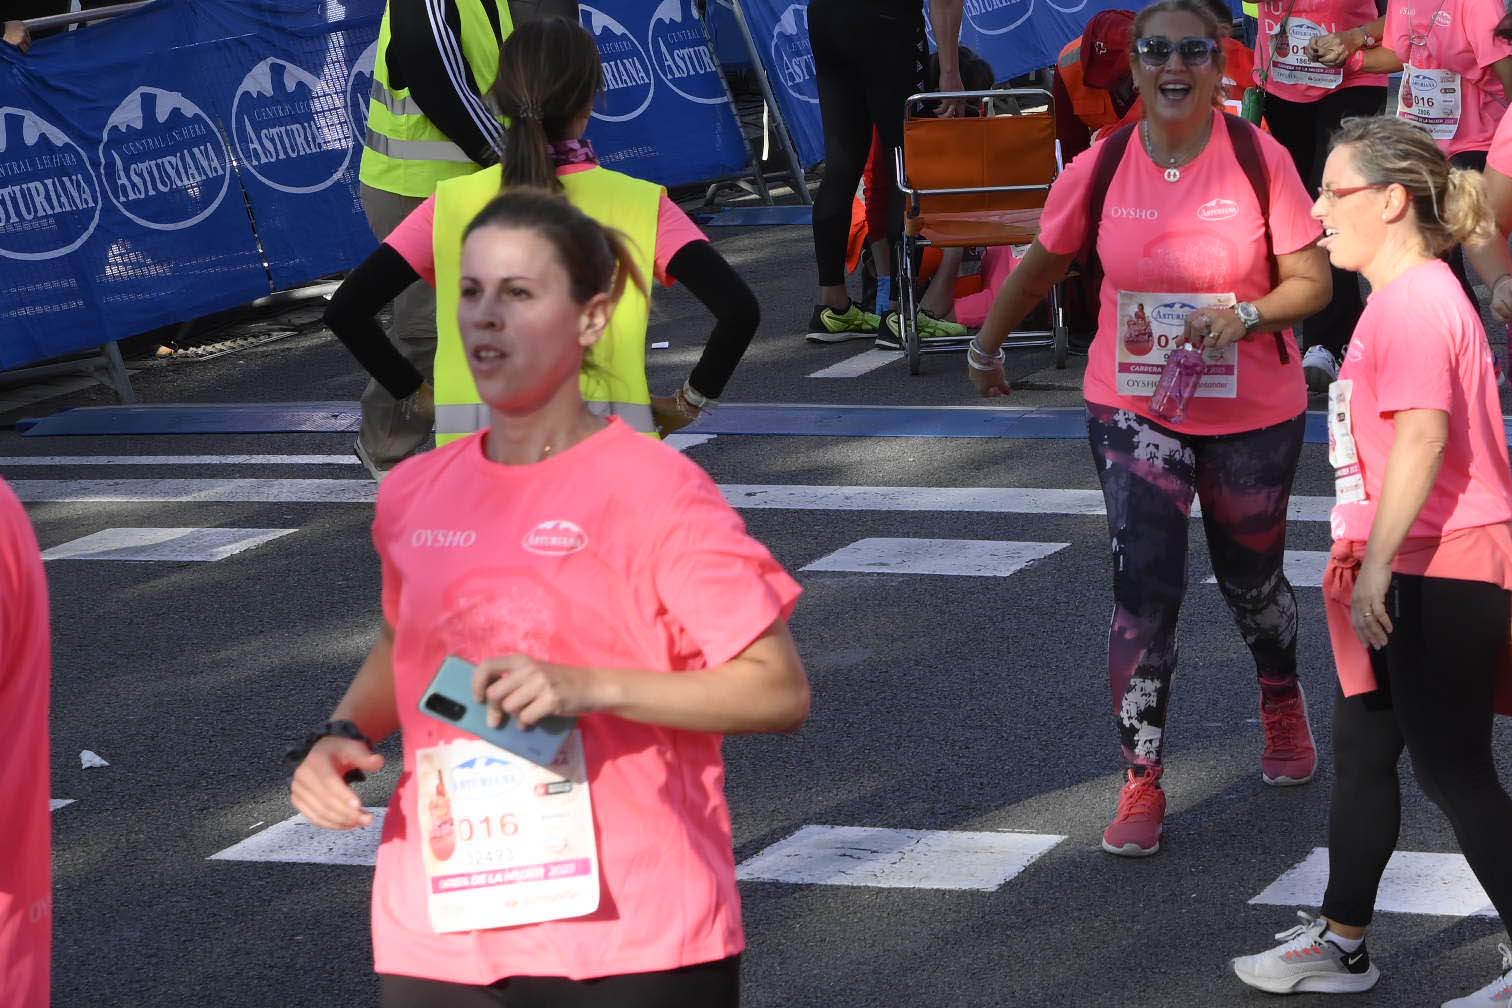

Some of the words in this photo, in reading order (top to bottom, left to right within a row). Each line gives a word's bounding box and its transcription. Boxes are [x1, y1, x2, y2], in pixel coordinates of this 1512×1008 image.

[1292, 44, 1306, 55] 01
[1414, 96, 1435, 108] 016
[123, 135, 165, 154] CENTRAL
[112, 143, 224, 202] ASTURIANA
[1111, 206, 1158, 220] OYSHO
[1130, 365, 1163, 373] CARRERA
[411, 528, 477, 548] OYSHO
[459, 812, 519, 841] 016
